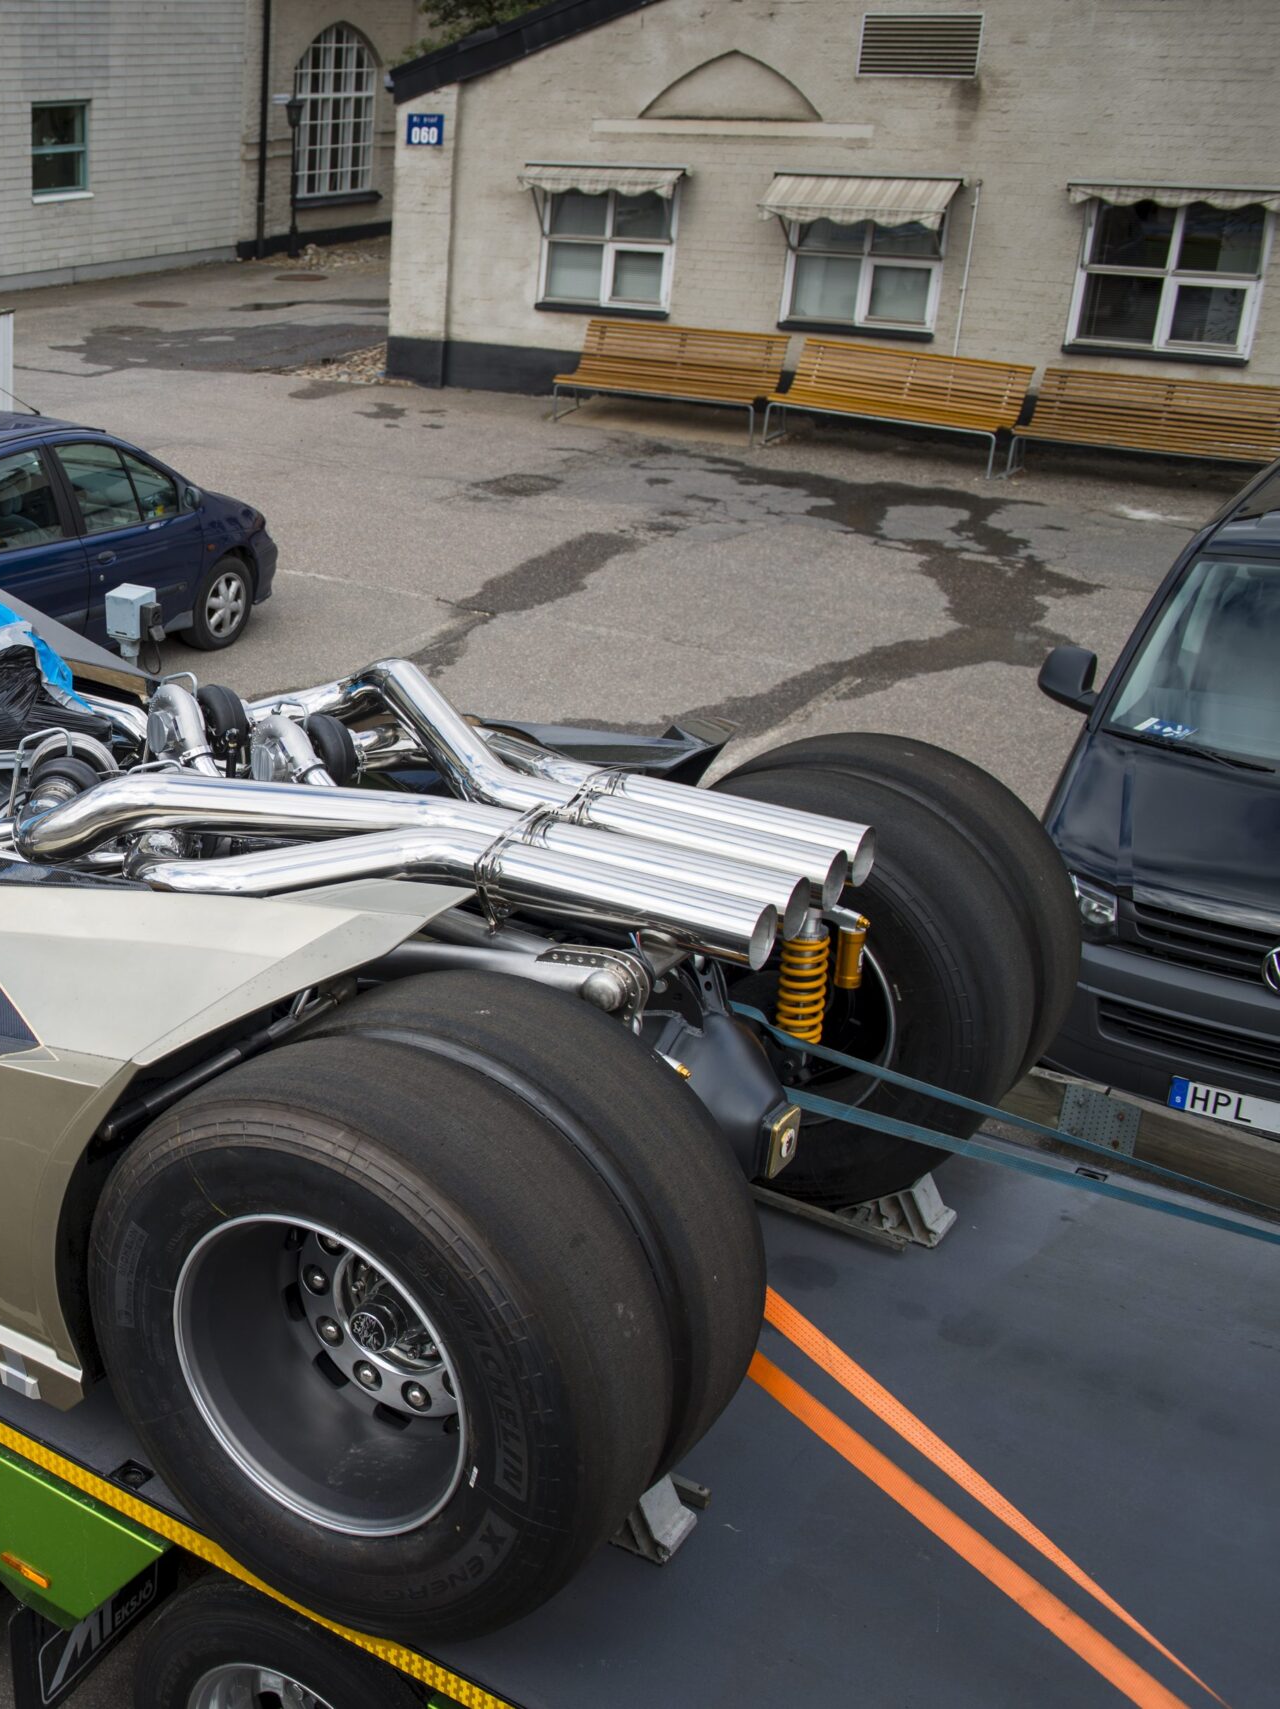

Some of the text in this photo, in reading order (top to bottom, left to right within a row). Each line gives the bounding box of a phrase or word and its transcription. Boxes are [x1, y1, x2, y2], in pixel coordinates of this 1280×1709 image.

[411, 126, 439, 144] 060
[1190, 1086, 1252, 1123] HPL
[446, 1296, 524, 1492] MICHELIN
[114, 1579, 153, 1626] EKSJÖ
